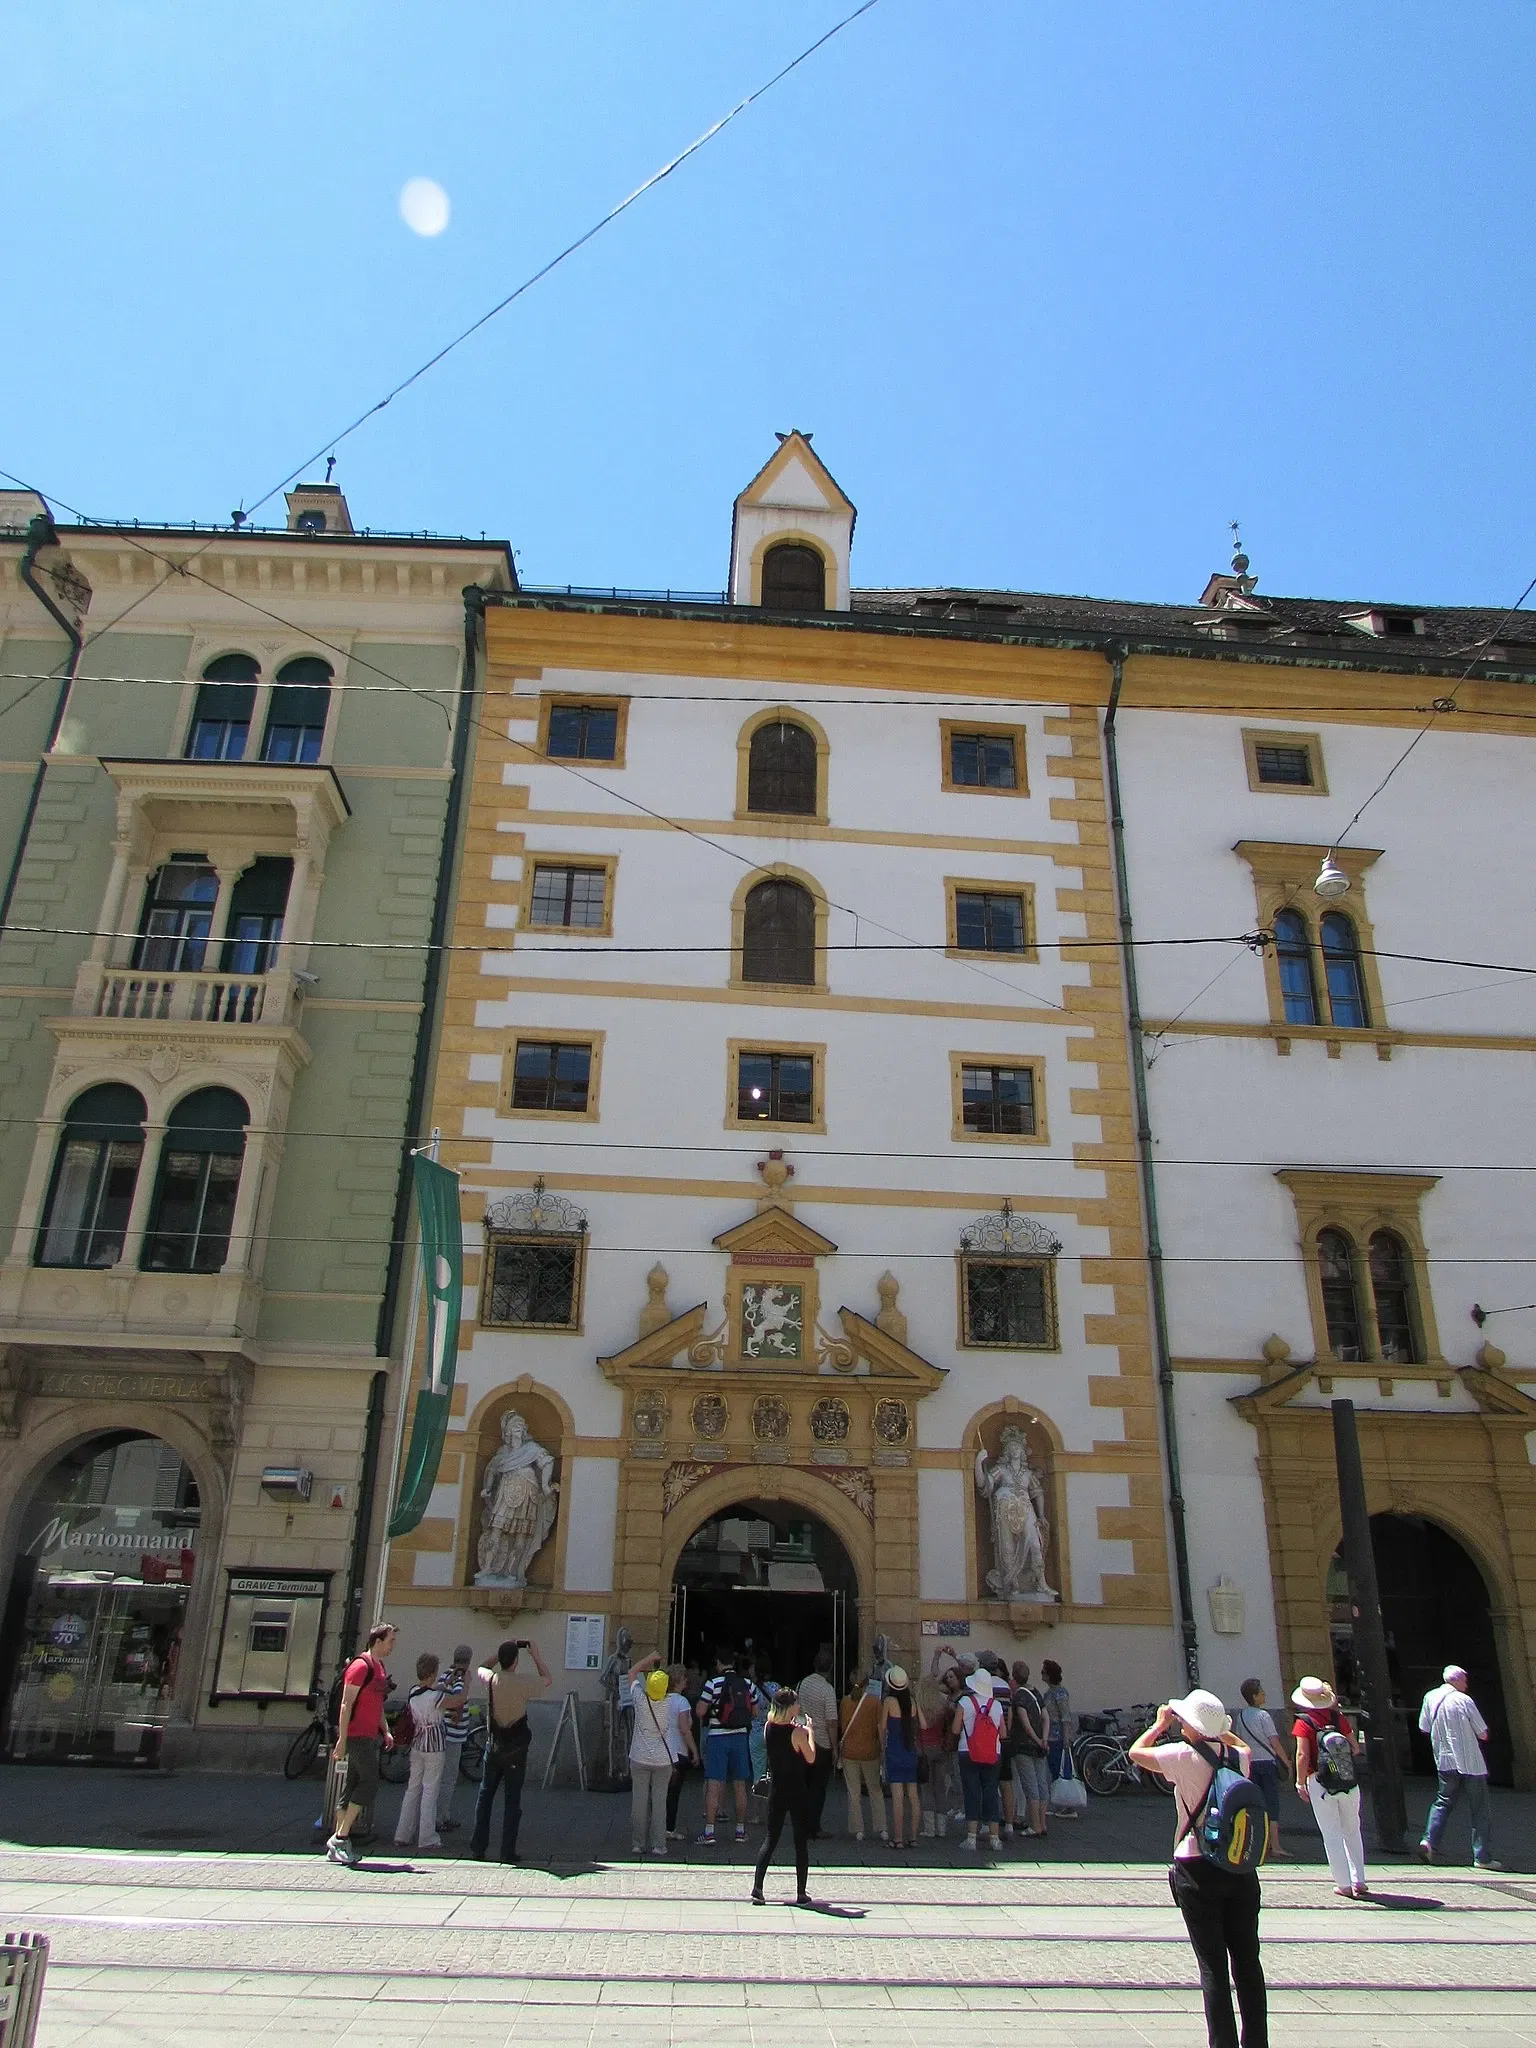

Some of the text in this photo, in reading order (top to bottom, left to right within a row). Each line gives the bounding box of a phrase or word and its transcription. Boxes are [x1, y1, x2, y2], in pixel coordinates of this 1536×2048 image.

[25, 1516, 194, 1556] Marionnaud
[237, 1580, 317, 1592] GRAWE Terminal
